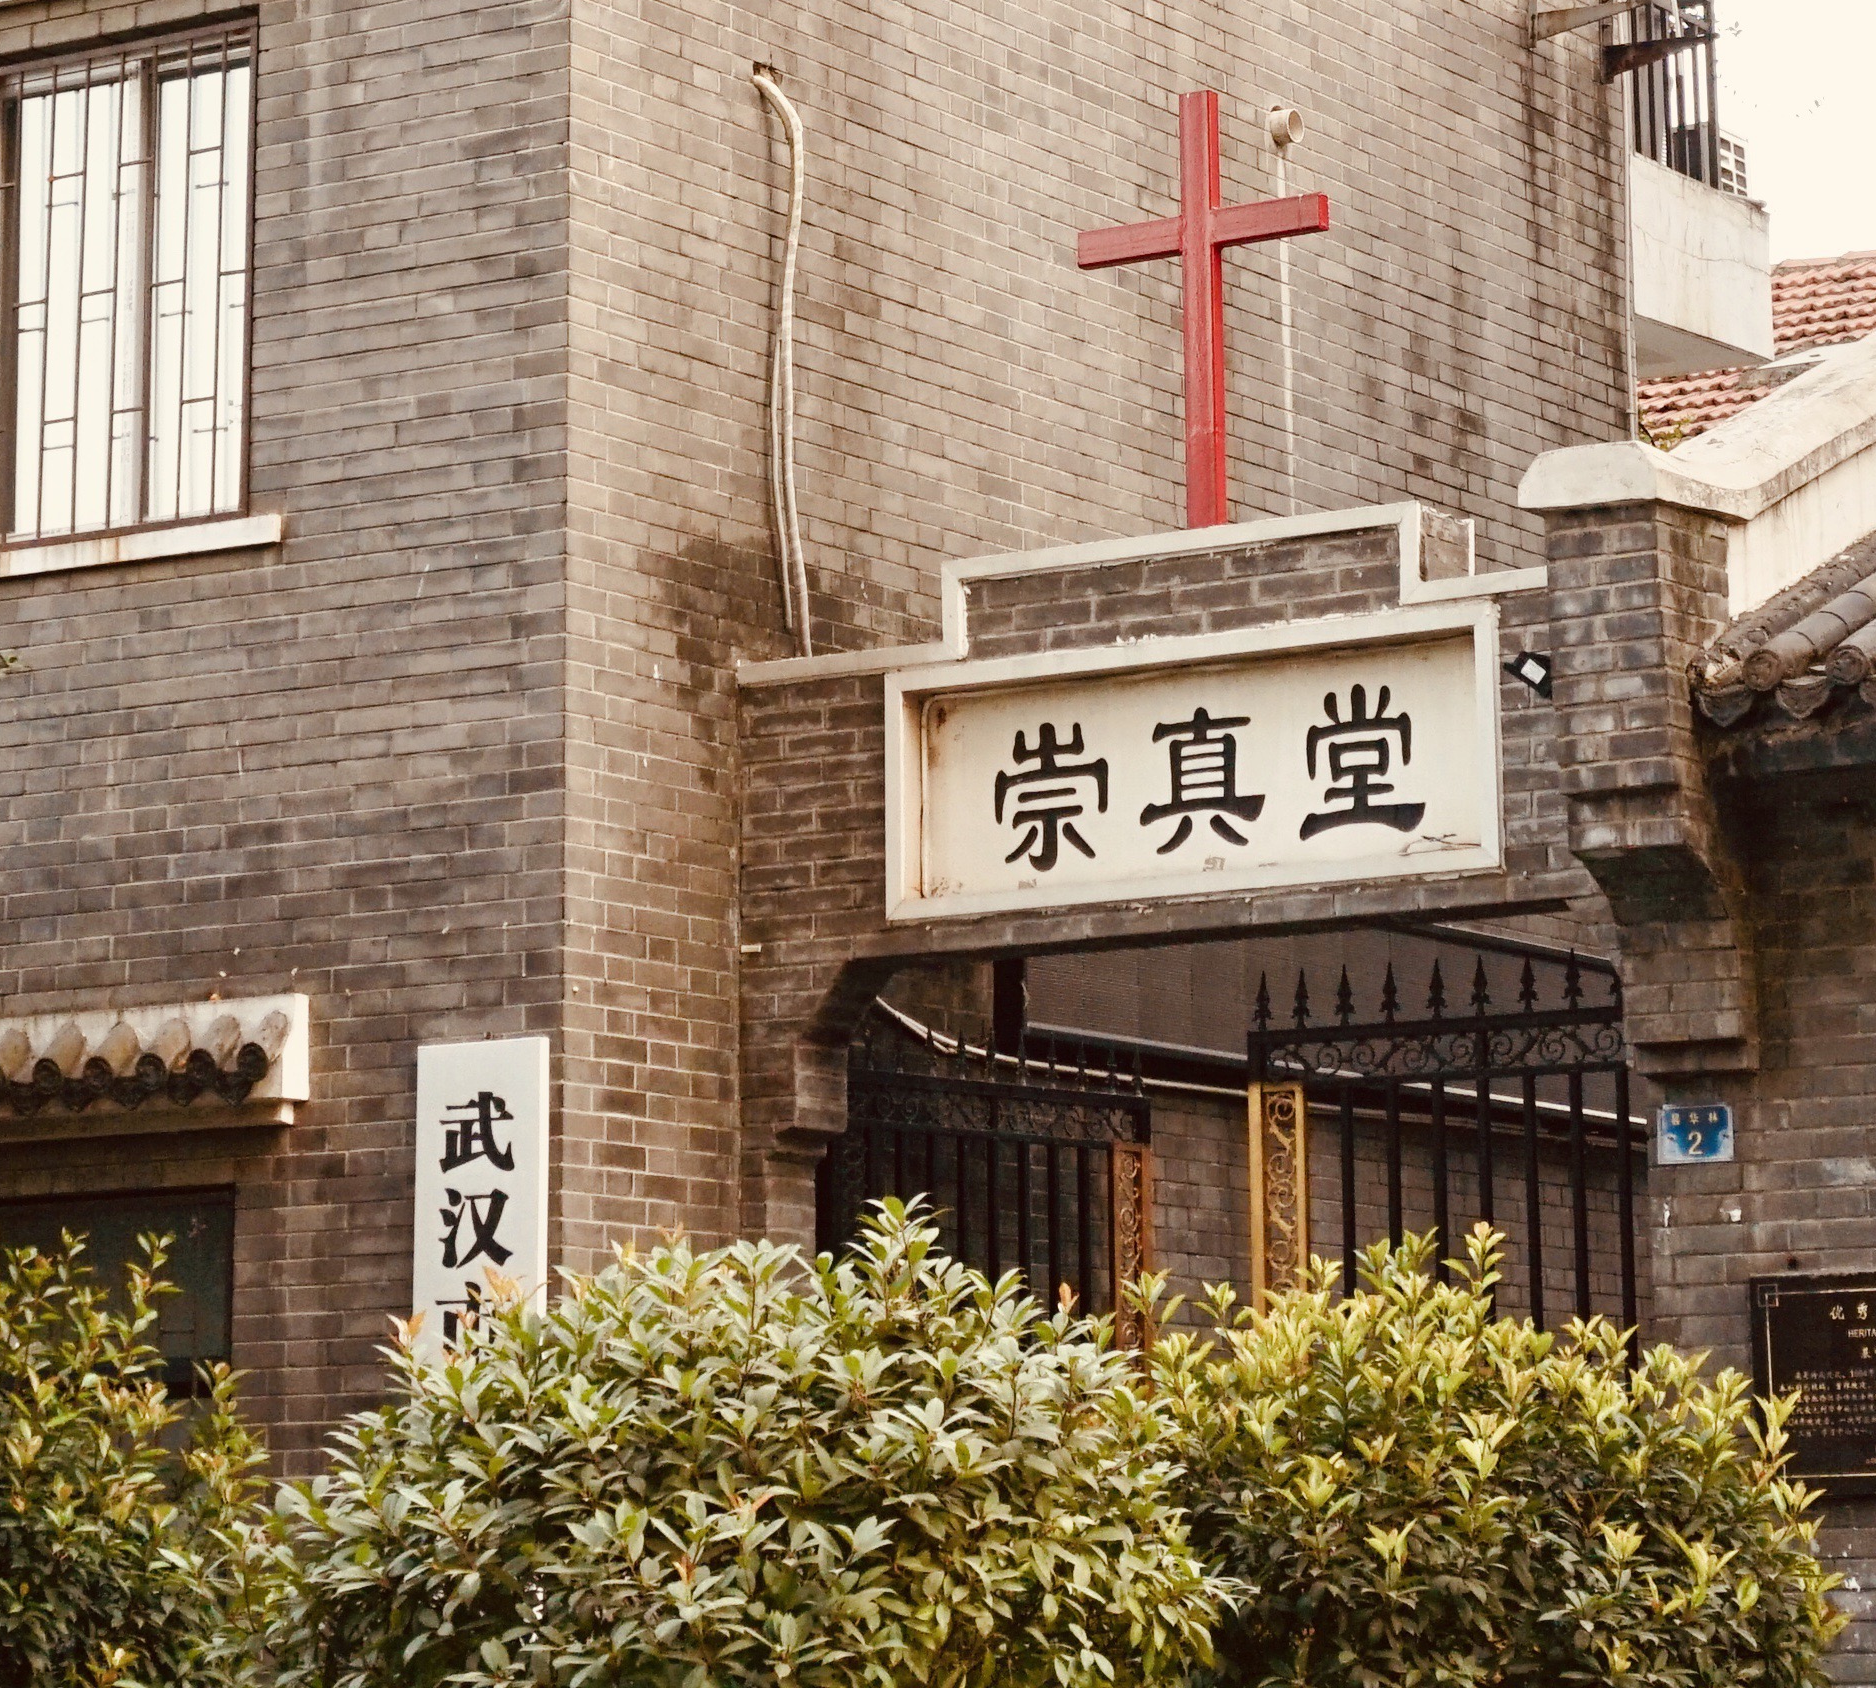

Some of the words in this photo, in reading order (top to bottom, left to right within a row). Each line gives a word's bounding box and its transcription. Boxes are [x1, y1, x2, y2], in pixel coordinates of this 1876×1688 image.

[994, 683, 1427, 871] 崇真堂
[1688, 1131, 1704, 1155] 2
